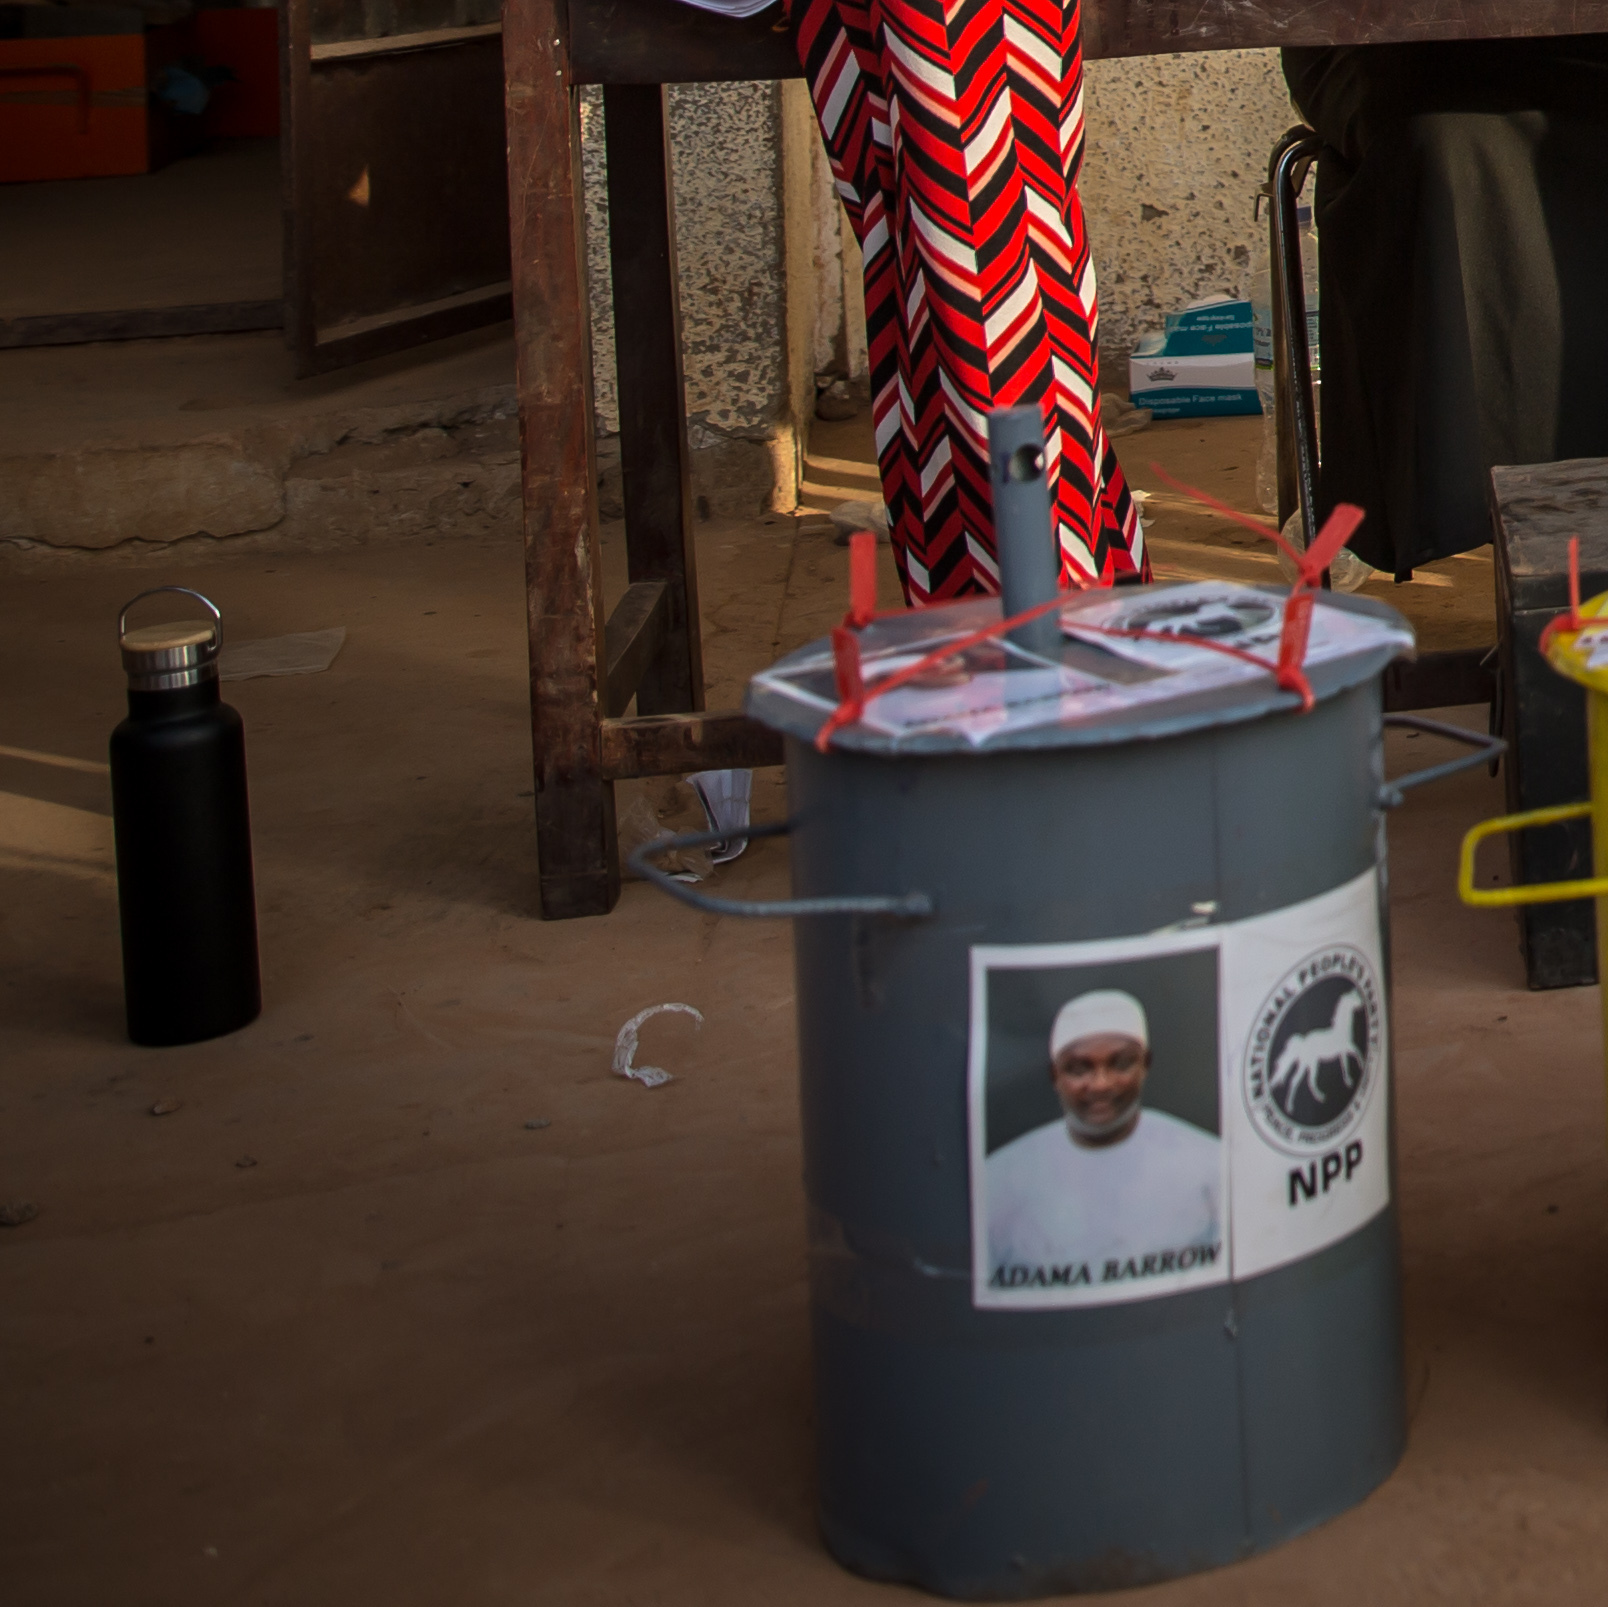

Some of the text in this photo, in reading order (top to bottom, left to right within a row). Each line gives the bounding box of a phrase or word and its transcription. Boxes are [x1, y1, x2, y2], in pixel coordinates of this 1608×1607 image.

[1250, 986, 1296, 1099] NATIONAL
[1287, 1139, 1364, 1208] NPP
[986, 1238, 1223, 1288] ADAMA BARROW
